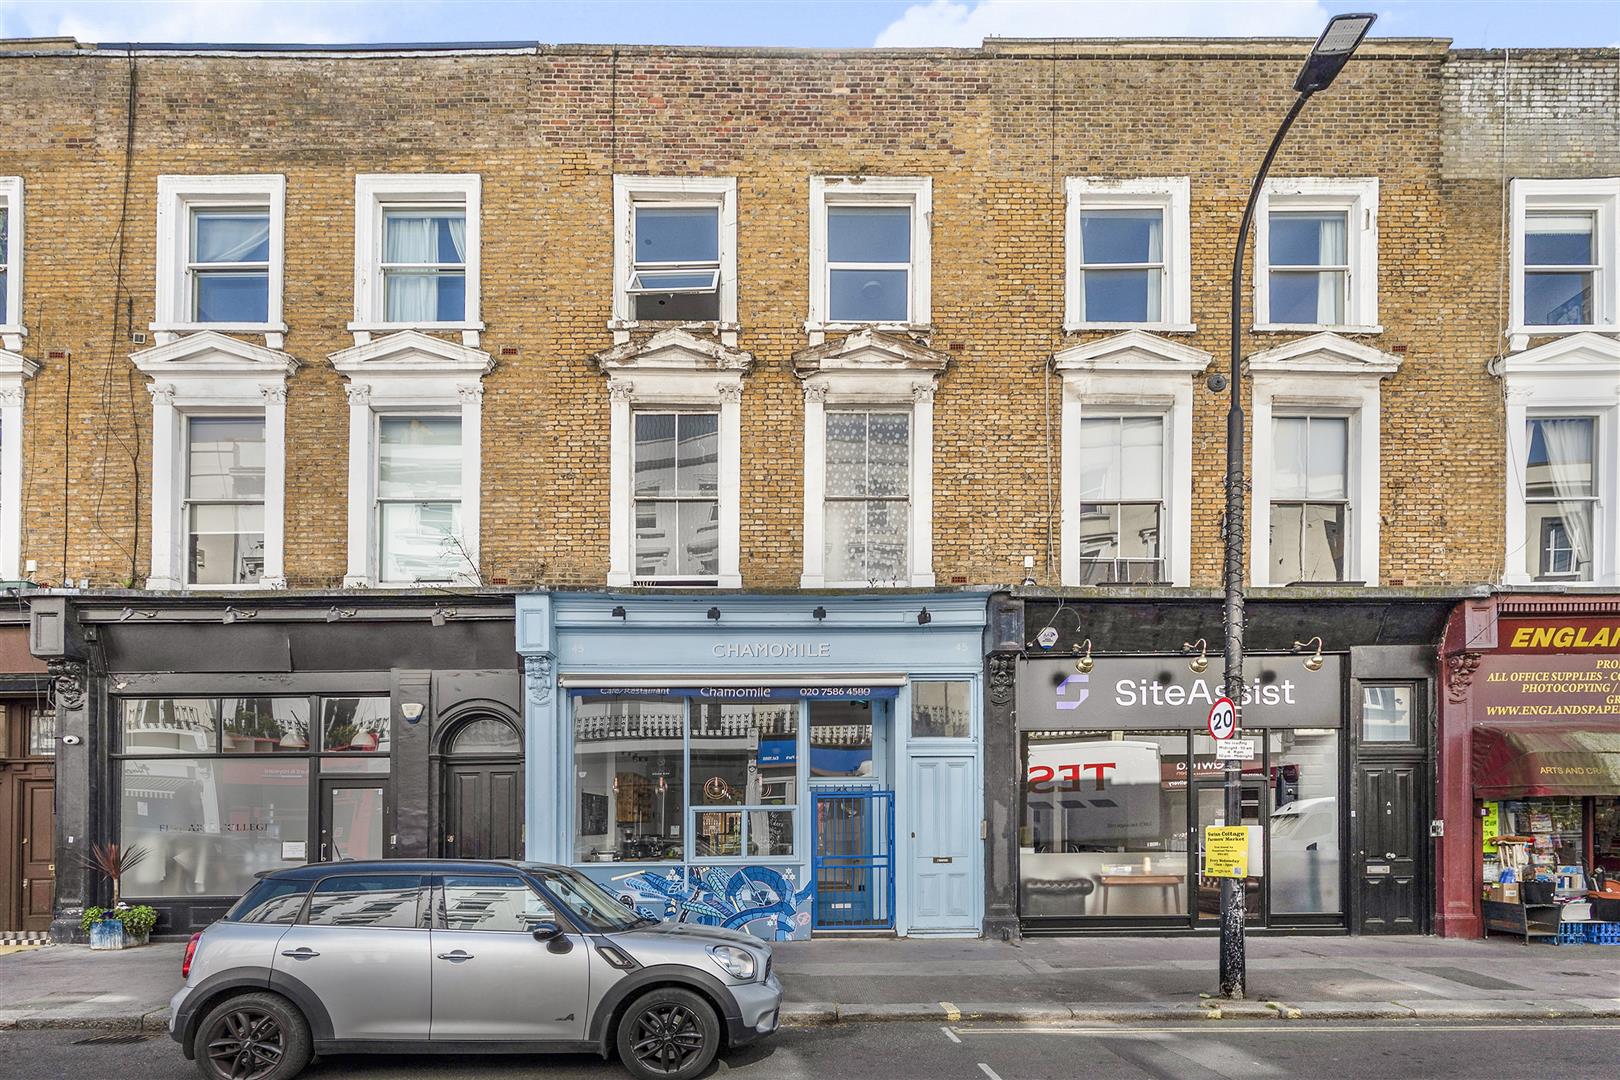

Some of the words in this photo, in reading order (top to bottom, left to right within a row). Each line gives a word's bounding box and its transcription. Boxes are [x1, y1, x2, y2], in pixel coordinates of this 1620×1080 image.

[712, 643, 831, 657] CHAMOMILE
[1596, 660, 1620, 669] PRO
[1487, 672, 1508, 681] ALL
[1510, 672, 1550, 681] OFFICE
[1551, 671, 1603, 681] SUPPLIES
[700, 687, 771, 698] Chamomile
[799, 687, 819, 696] 020
[821, 687, 844, 696] 7586
[1521, 683, 1611, 693] PHOTOCOPYING
[1486, 705, 1620, 716] WWW.ENGLANDSPAPE
[1213, 709, 1233, 730] 20
[1540, 766, 1563, 775] ARTS
[1565, 766, 1584, 775] AND
